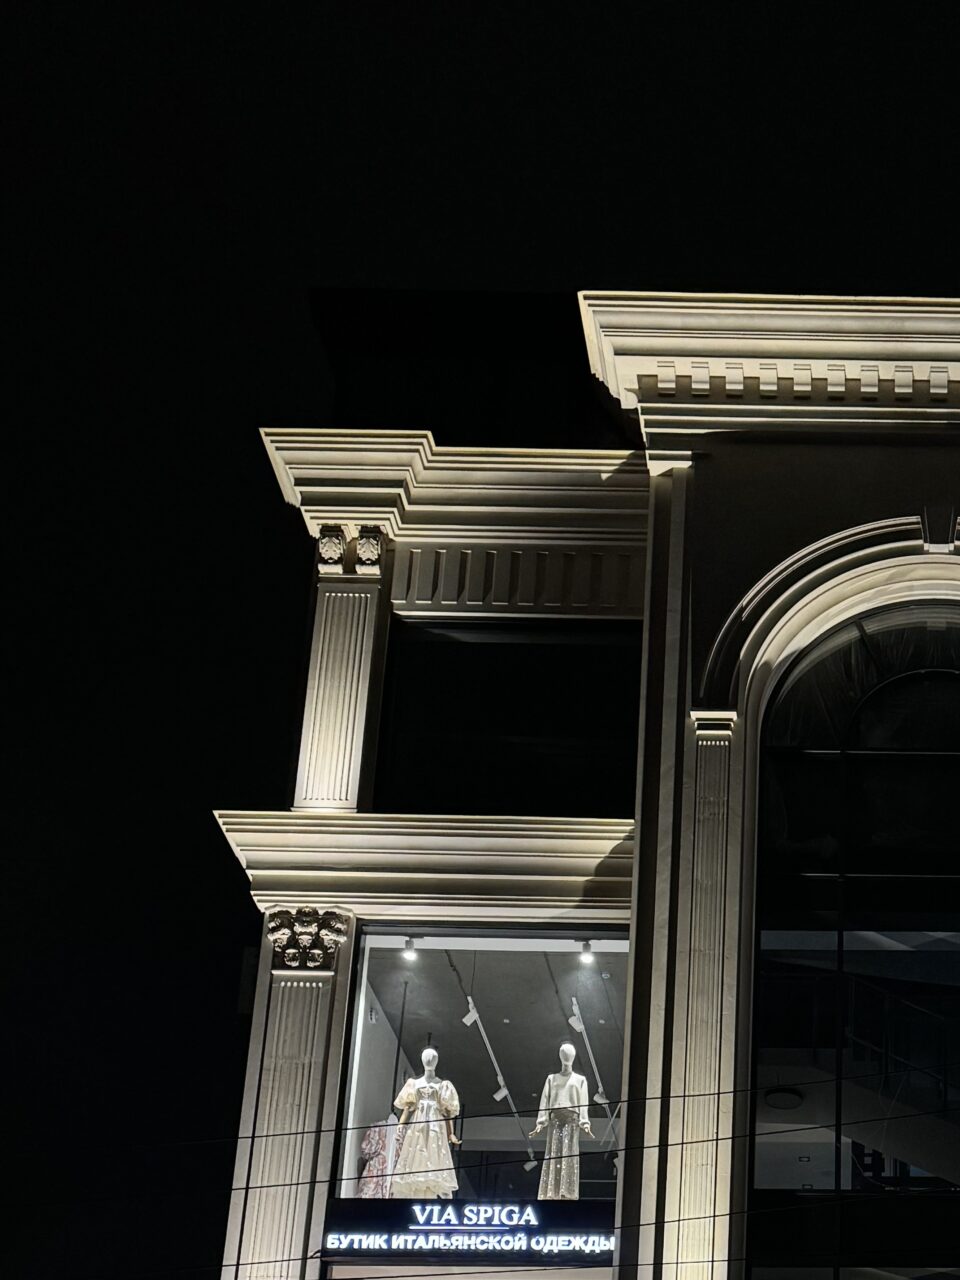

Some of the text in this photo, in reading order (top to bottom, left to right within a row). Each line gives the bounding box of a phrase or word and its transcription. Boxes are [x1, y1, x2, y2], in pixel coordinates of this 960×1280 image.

[412, 1205, 539, 1225] VIA SPIGA
[326, 1233, 616, 1254] БУТИК ИТАЛЬЯНСКОЙ ОДЕЖДЫ
